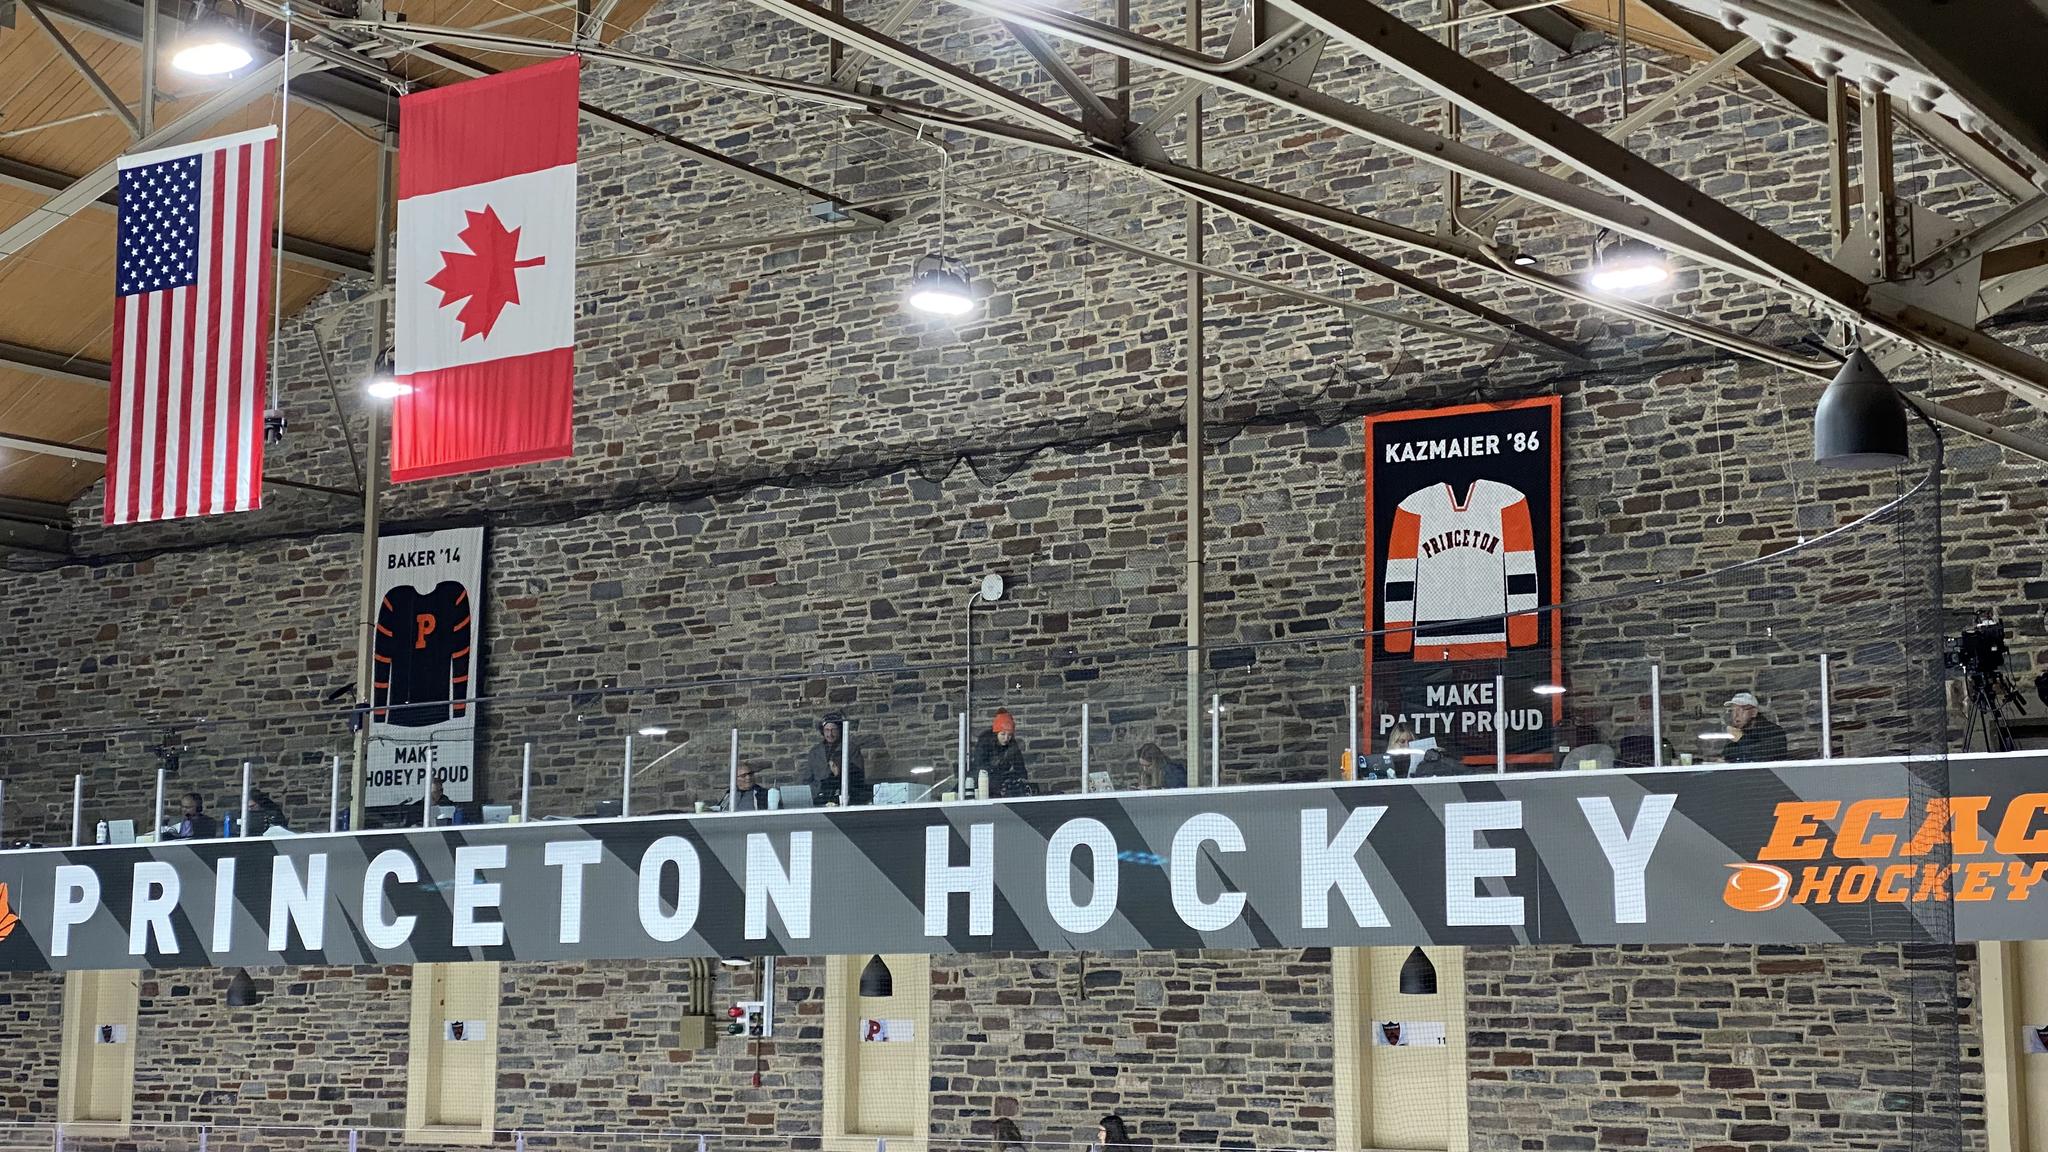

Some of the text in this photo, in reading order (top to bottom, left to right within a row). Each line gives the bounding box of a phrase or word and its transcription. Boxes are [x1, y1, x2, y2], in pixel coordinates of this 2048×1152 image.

[1385, 430, 1540, 463] KAZMAIER '86
[388, 547, 460, 569] BAKER '14
[1422, 529, 1500, 558] PRINCETON
[415, 613, 436, 649] P
[1426, 682, 1494, 706] MAKE
[394, 745, 438, 764] MAKE
[1757, 792, 2048, 861] ECAC
[51, 793, 1678, 958] PRINCETON HOCKEY
[1792, 861, 2048, 904] HOCKEY
